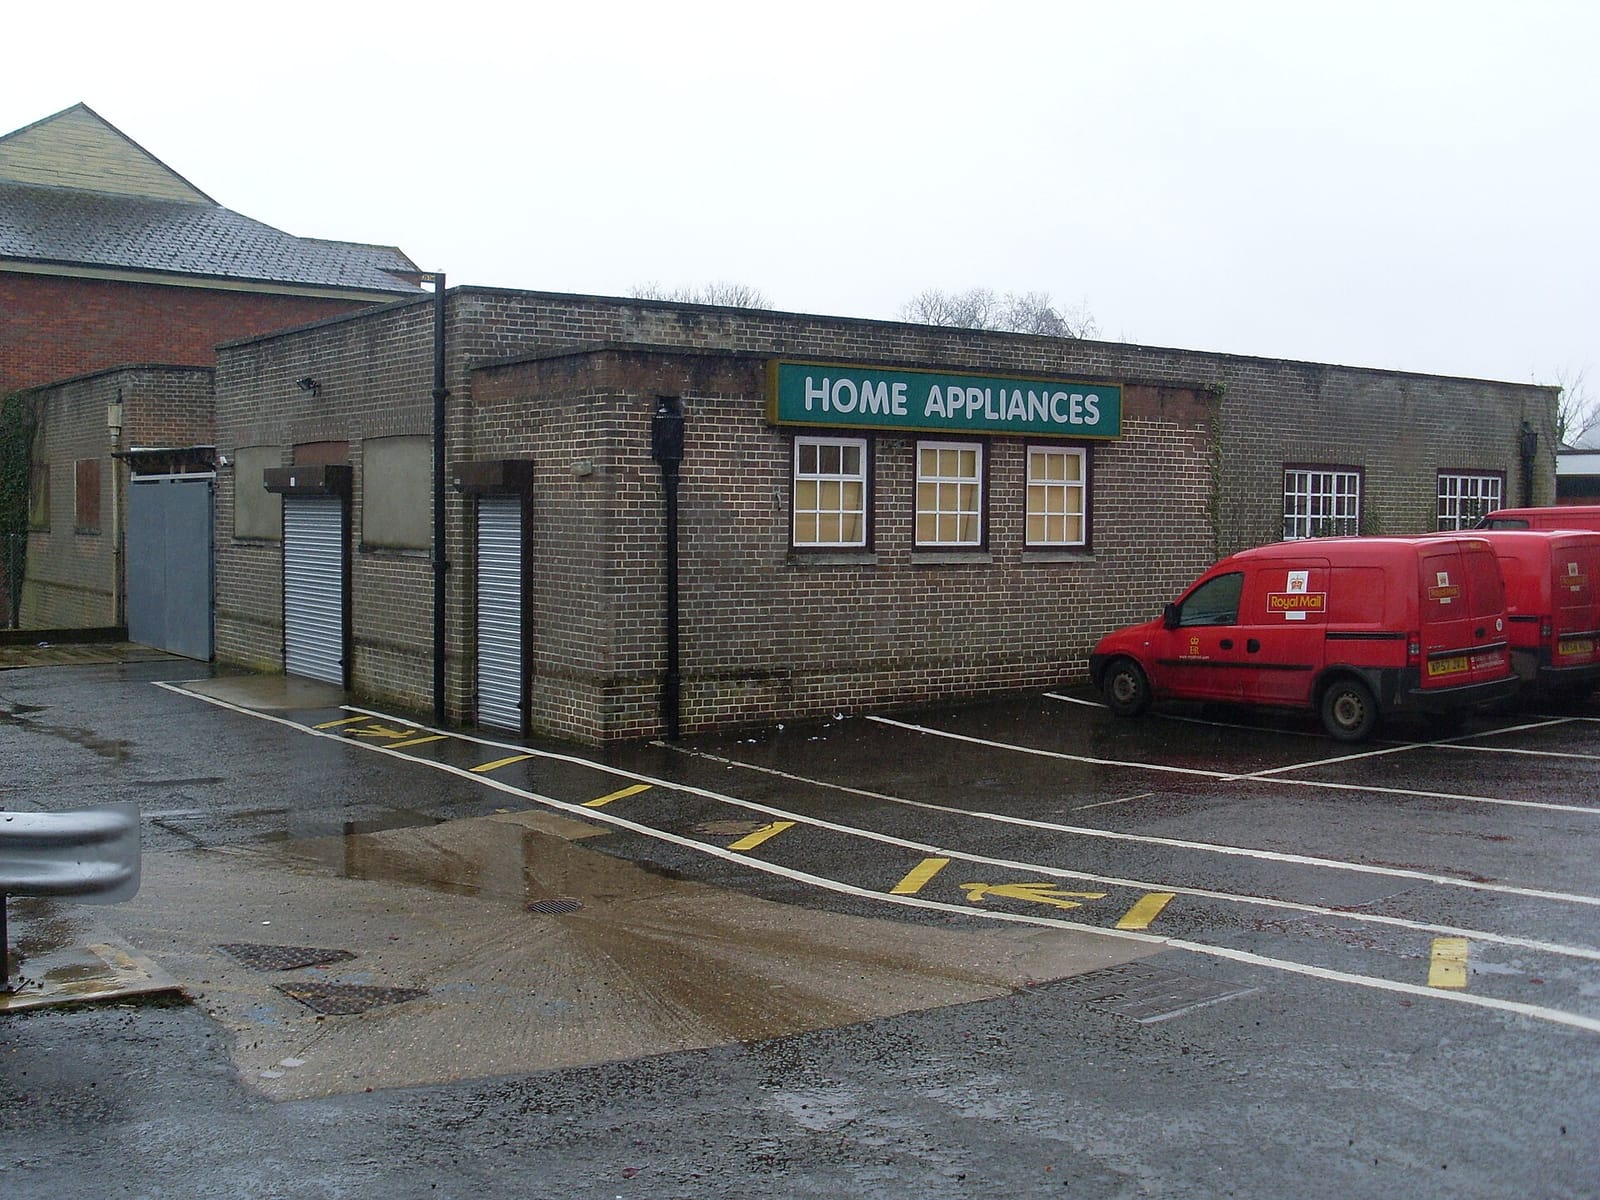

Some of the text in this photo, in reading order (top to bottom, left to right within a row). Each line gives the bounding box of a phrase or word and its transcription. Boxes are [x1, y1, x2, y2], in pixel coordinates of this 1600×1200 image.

[804, 376, 1100, 425] HOME APPLIANCES
[1271, 595, 1322, 610] Royal Mail
